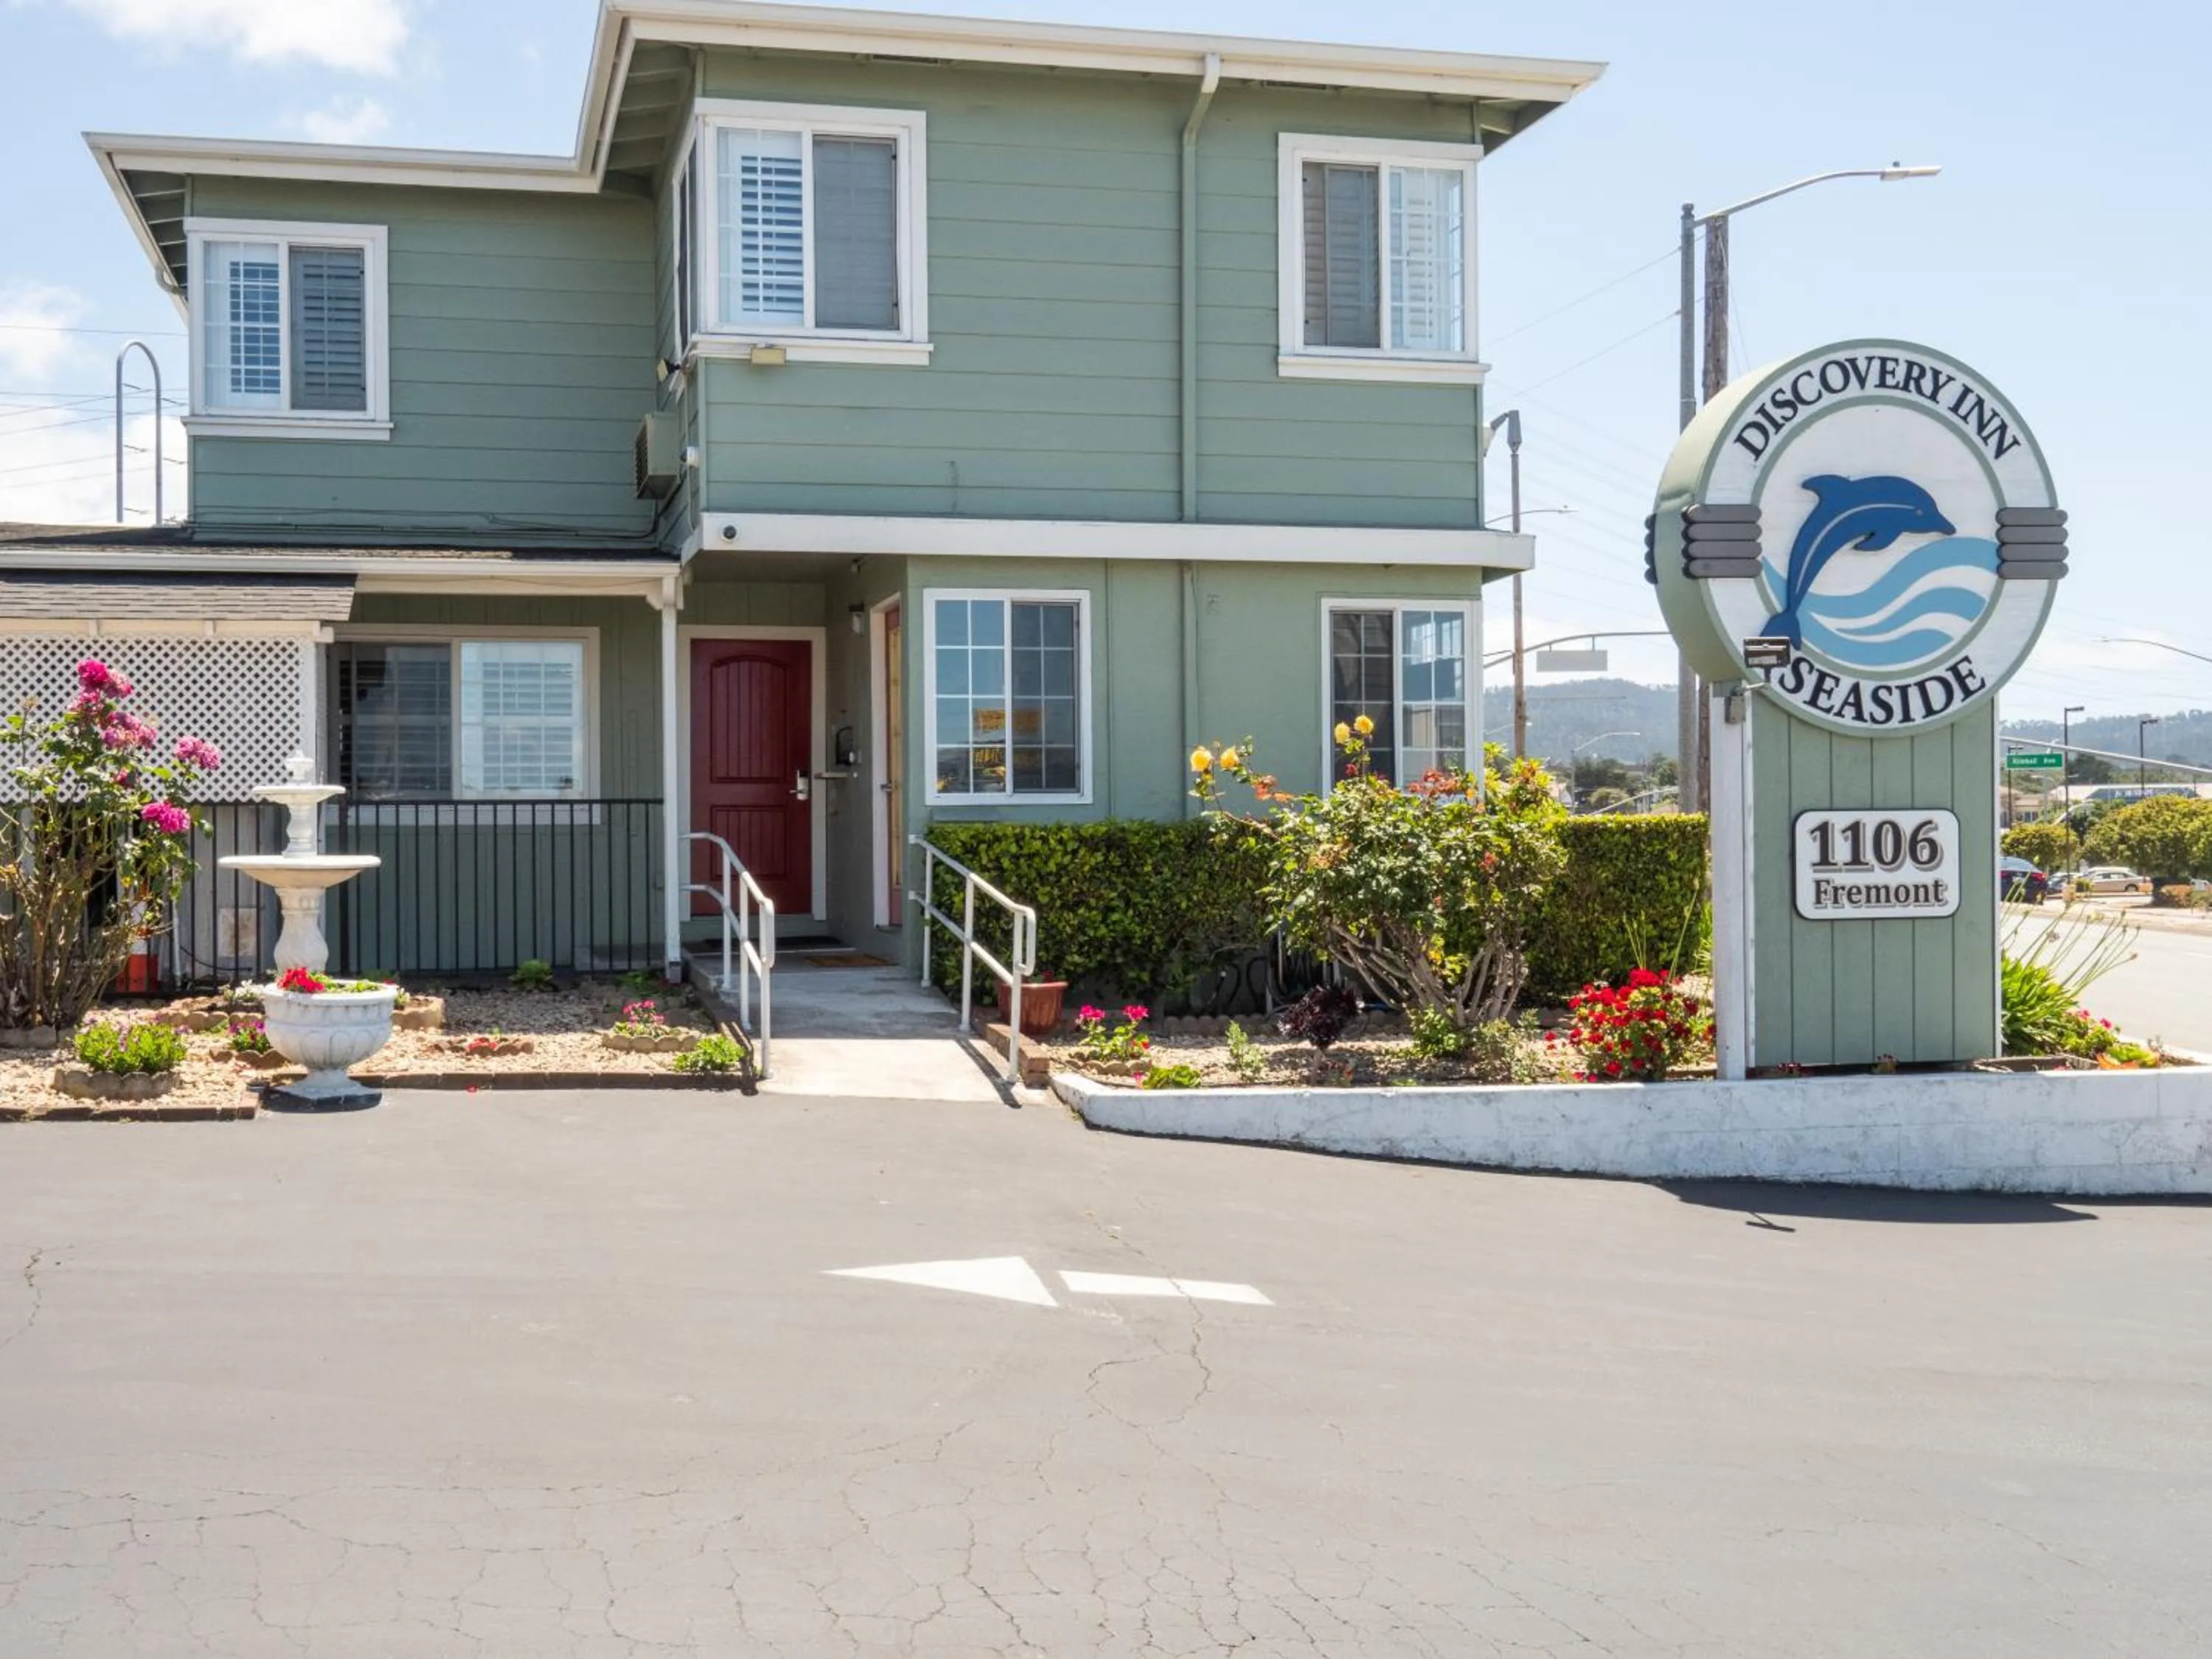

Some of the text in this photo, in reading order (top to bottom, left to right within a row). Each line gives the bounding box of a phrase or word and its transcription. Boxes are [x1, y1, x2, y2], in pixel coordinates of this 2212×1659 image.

[1733, 355, 2021, 462] DISCOVERY INN
[1778, 655, 1986, 725] SEASIDE
[1809, 819, 1944, 872] 1106
[1813, 879, 1947, 908] Fremont
